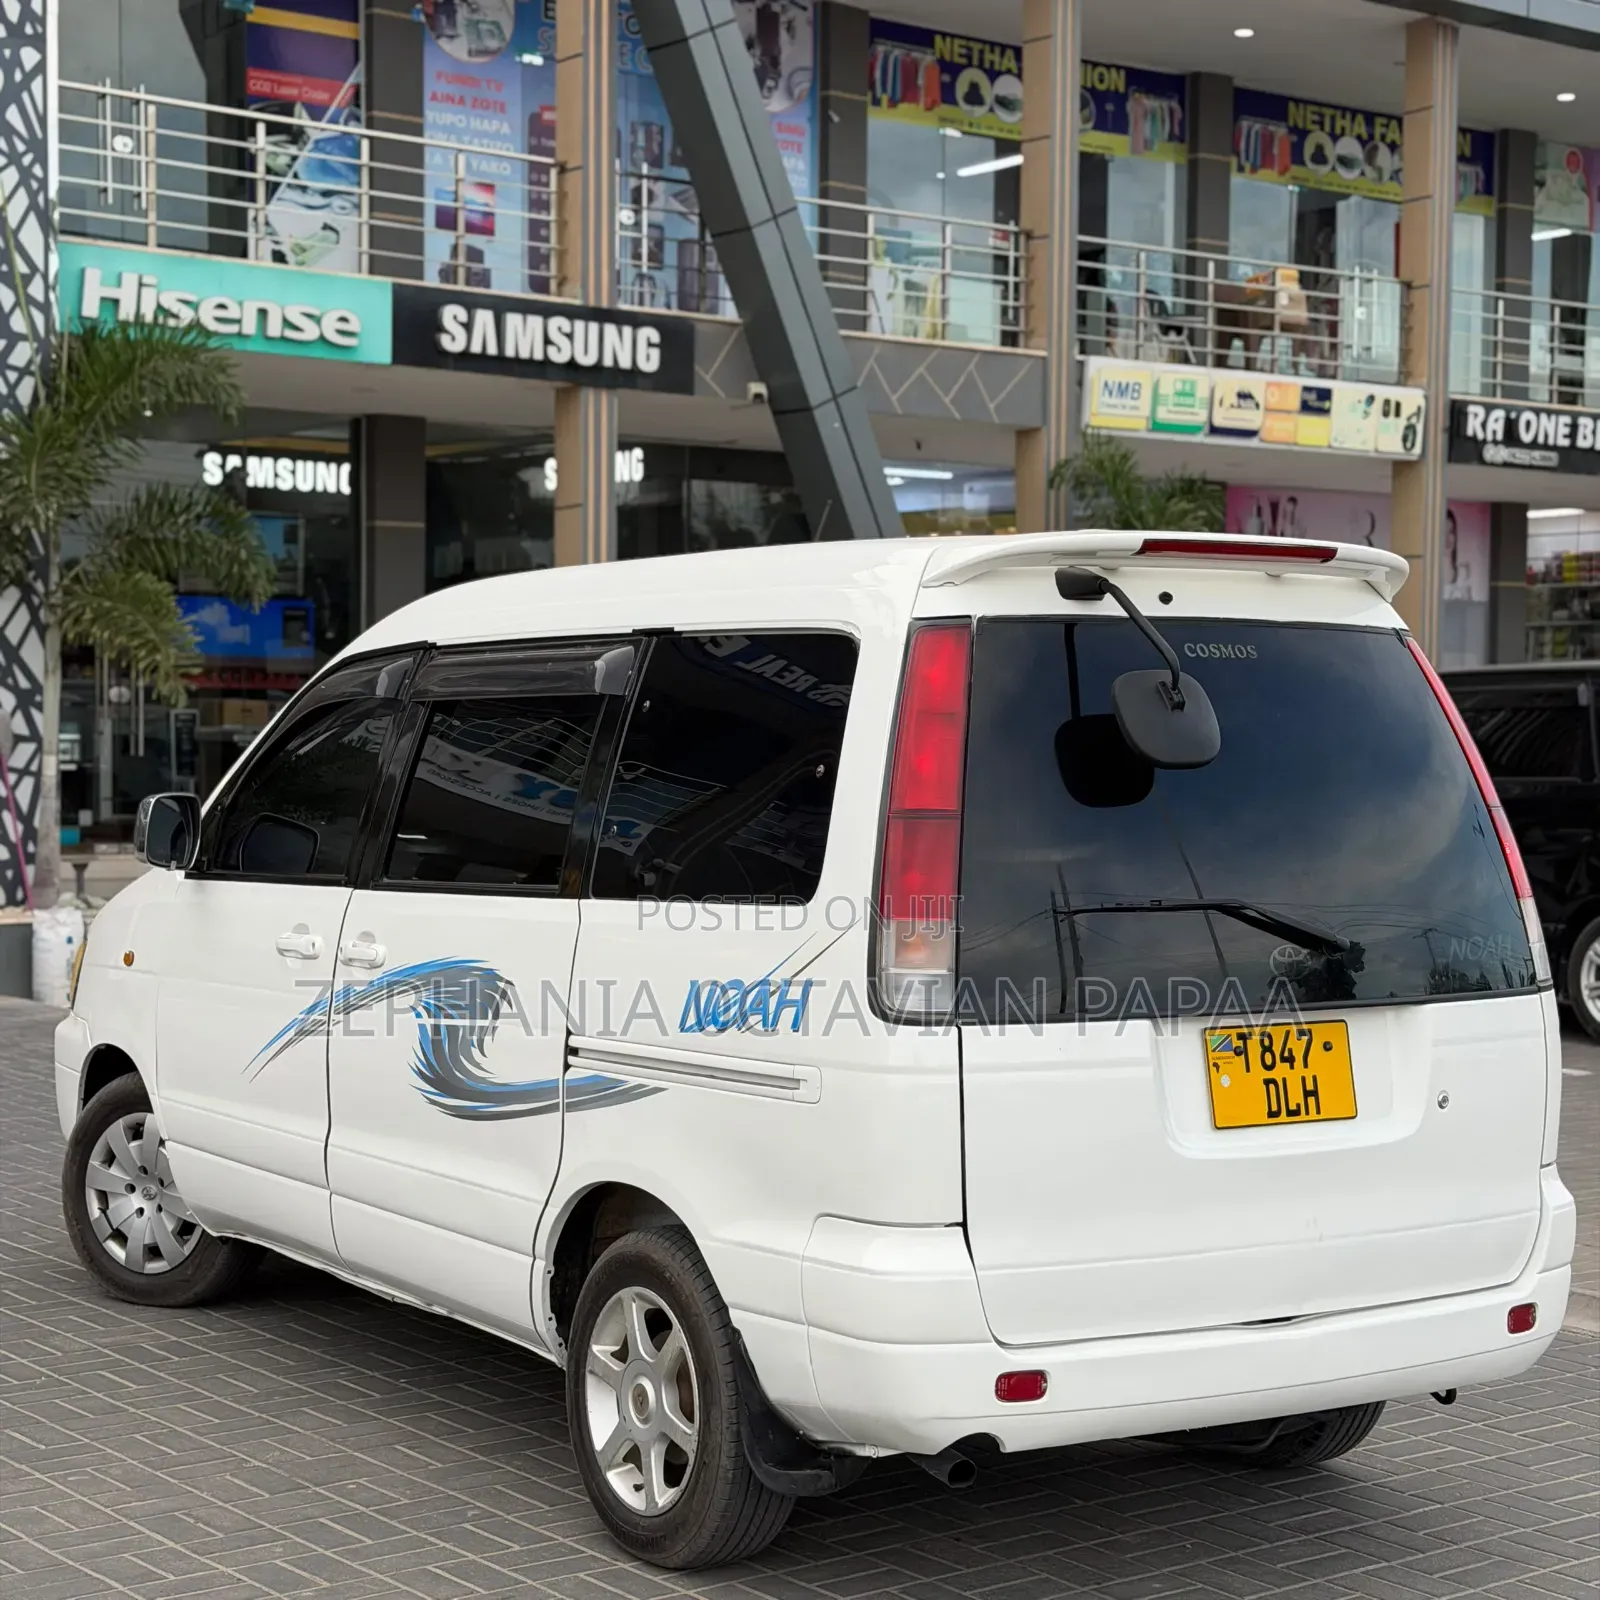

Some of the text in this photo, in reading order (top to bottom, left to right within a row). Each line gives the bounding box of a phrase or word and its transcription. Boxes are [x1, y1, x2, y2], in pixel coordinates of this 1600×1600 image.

[933, 33, 1019, 75] NETHA
[428, 90, 507, 115] AINA ZOTE
[1287, 100, 1369, 141] NETHA
[469, 116, 512, 135] HAPA
[80, 266, 362, 348] Hisense
[437, 303, 662, 373] SAMSUNG
[1102, 380, 1142, 401] NMB
[1183, 642, 1258, 659] COSMOS
[1449, 934, 1512, 964] NOAH
[678, 977, 814, 1034] NOAH
[1262, 1074, 1321, 1118] DLH
